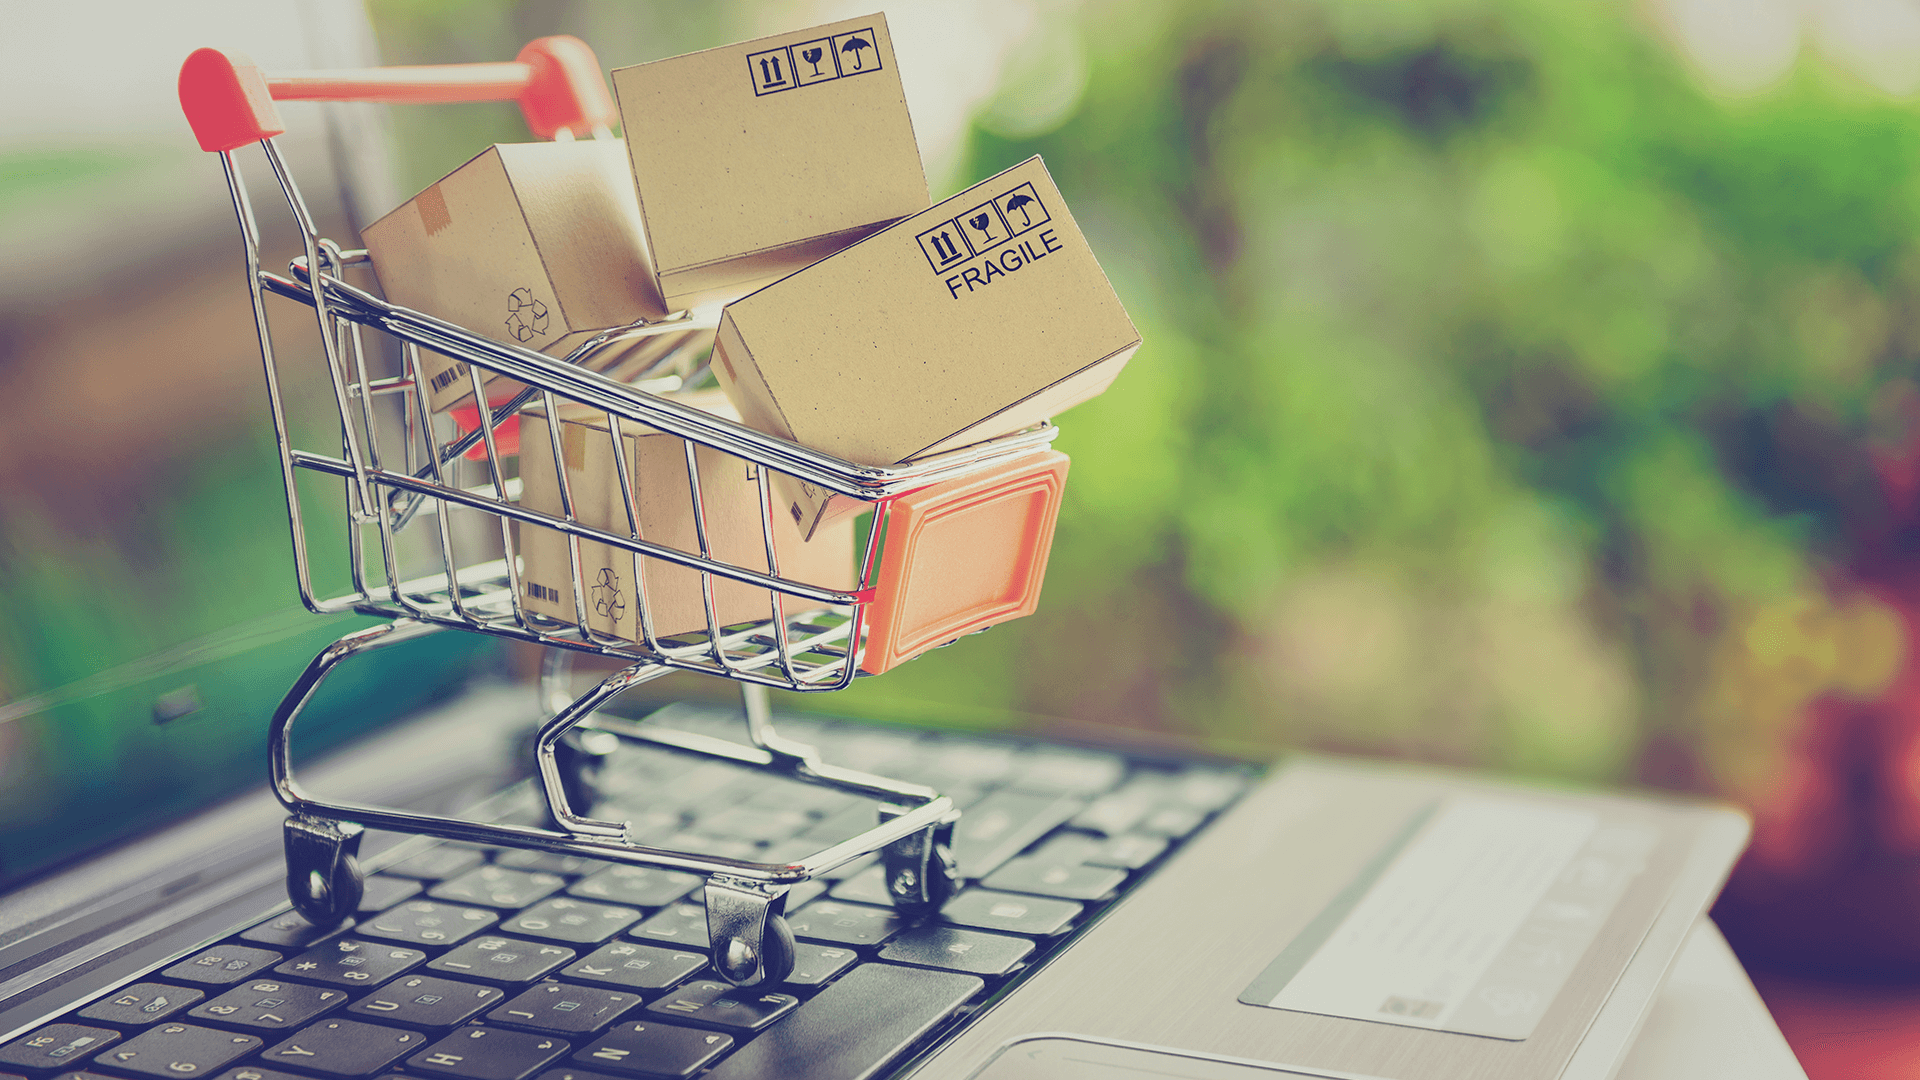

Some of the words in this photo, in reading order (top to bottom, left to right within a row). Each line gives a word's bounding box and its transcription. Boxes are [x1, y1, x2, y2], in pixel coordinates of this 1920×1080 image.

[945, 229, 1063, 300] FRAGILE
[421, 930, 446, 940] 9
[646, 929, 678, 937] L
[196, 956, 222, 967] F8
[578, 964, 613, 975] K
[343, 971, 369, 980] 8
[114, 995, 140, 1006] F7
[366, 1000, 399, 1011] U
[209, 1005, 239, 1015] &
[666, 1000, 704, 1013] M
[258, 1013, 283, 1022] 7
[508, 1010, 534, 1019] J
[25, 1036, 55, 1048] F6
[281, 1045, 315, 1056] Y
[592, 1047, 630, 1061] N
[426, 1053, 463, 1066] H
[169, 1061, 197, 1072] 6
